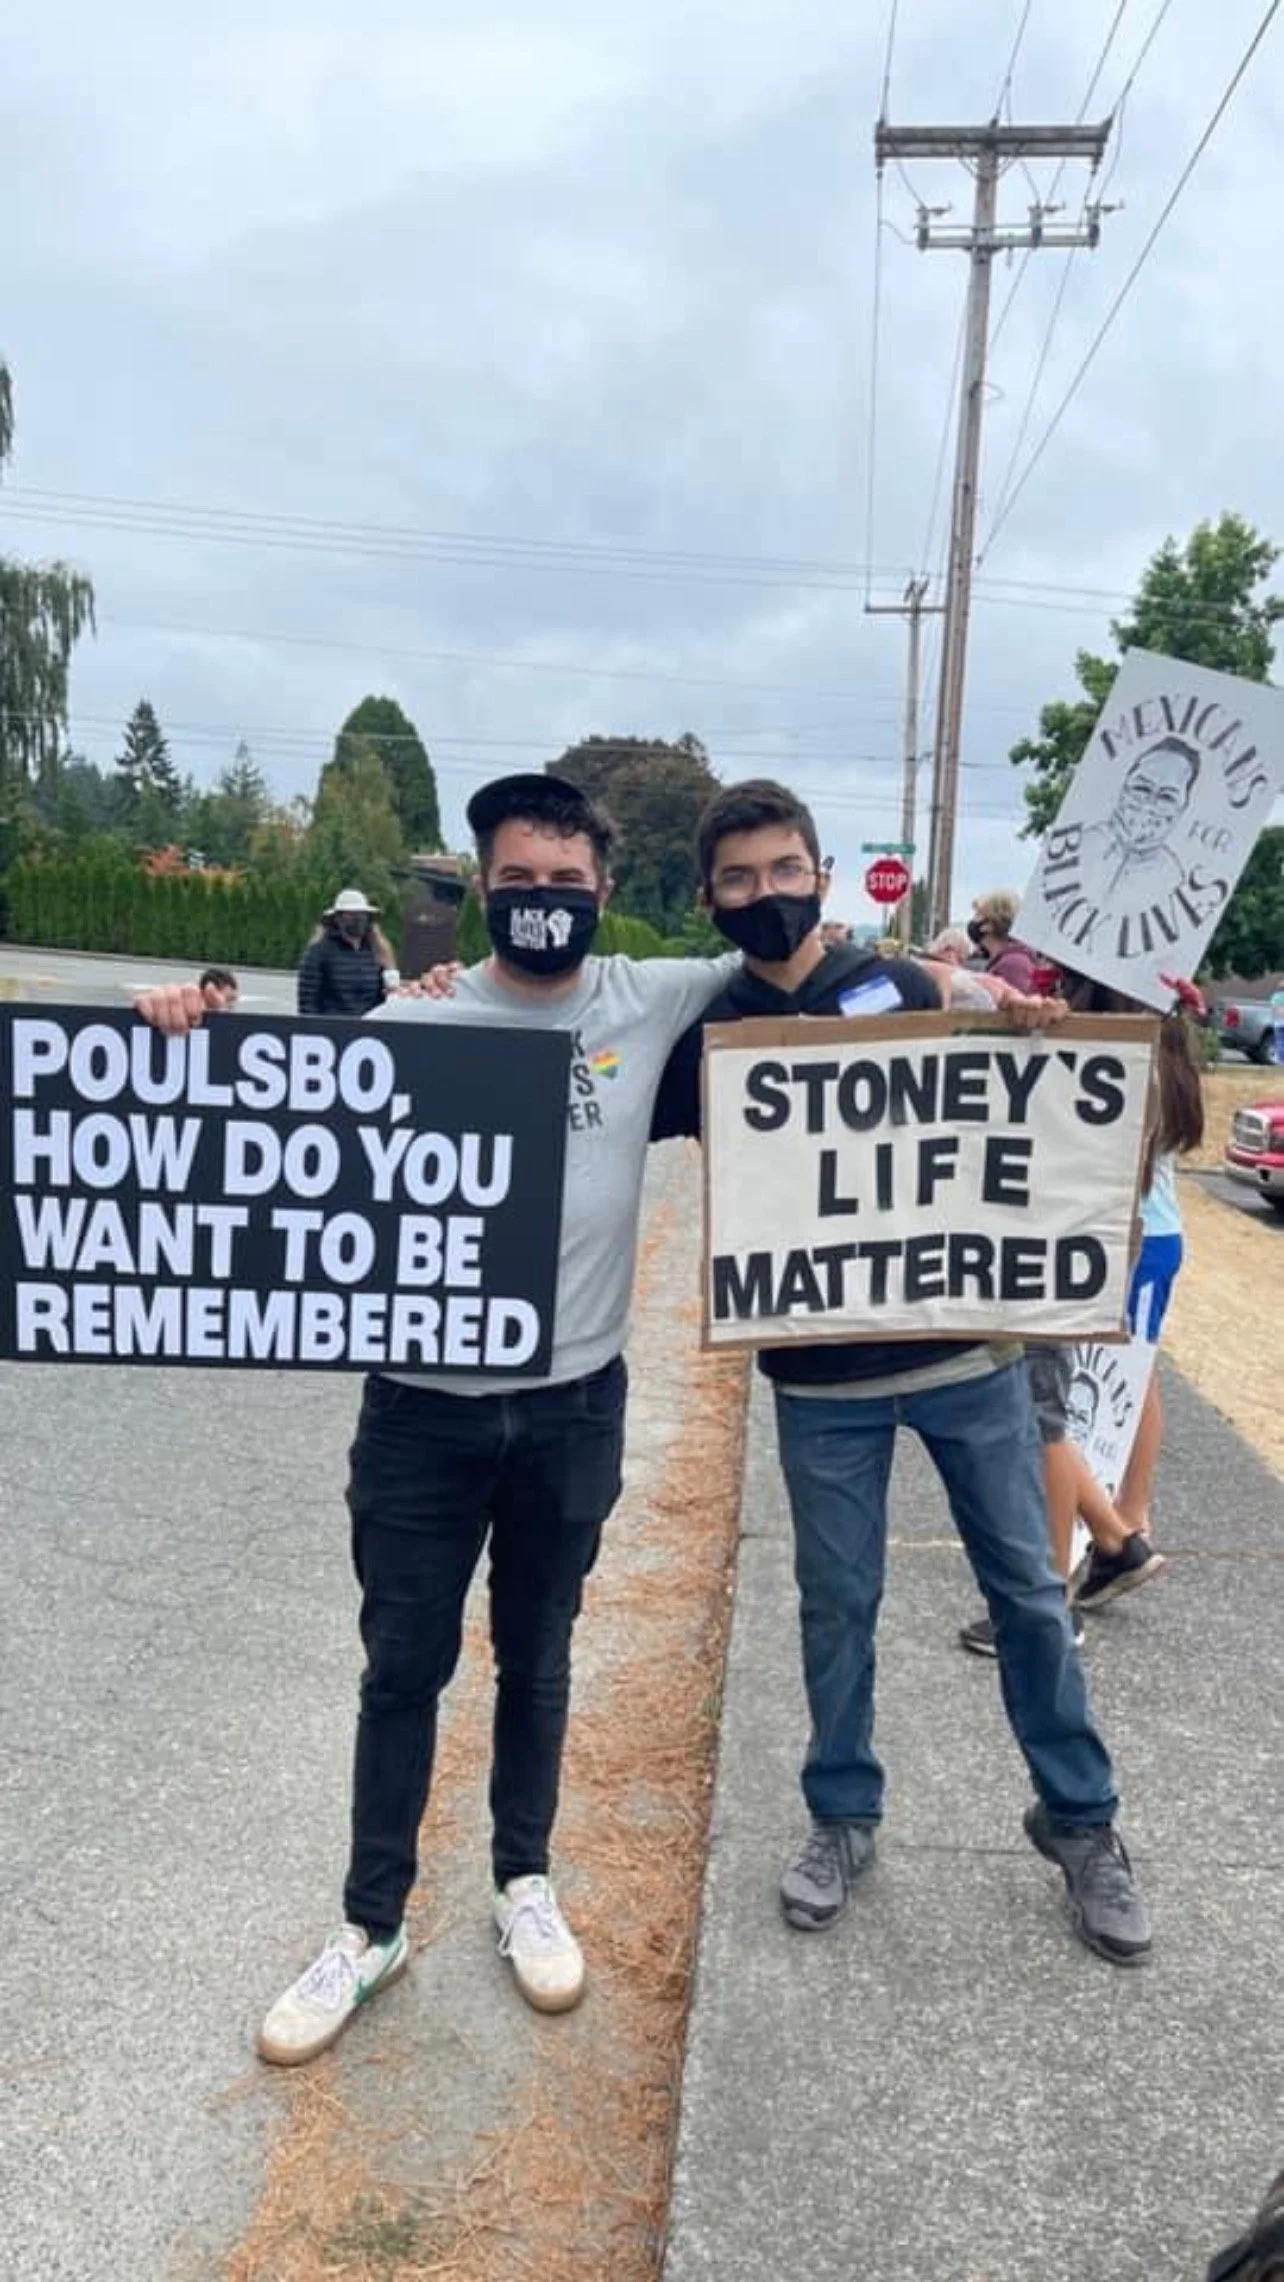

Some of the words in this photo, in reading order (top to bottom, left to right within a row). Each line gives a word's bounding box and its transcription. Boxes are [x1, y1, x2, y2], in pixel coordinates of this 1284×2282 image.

[1100, 695, 1269, 810] MEXICANS
[869, 871, 907, 890] STOP
[1043, 821, 1113, 955] BLACK
[1116, 864, 1229, 959] LIVES
[11, 1019, 411, 1123] POULSBO,
[742, 1049, 1127, 1134] STONEY'S
[12, 1108, 203, 1192] HOW
[223, 1119, 342, 1198] DO
[357, 1126, 514, 1207] YOU
[817, 1136, 1034, 1218] LIFE
[14, 1194, 250, 1278] WANT
[271, 1208, 376, 1284] TO
[396, 1214, 485, 1288] BE
[712, 1233, 1108, 1321] MATTERED
[15, 1282, 541, 1367] REMEMBERED
